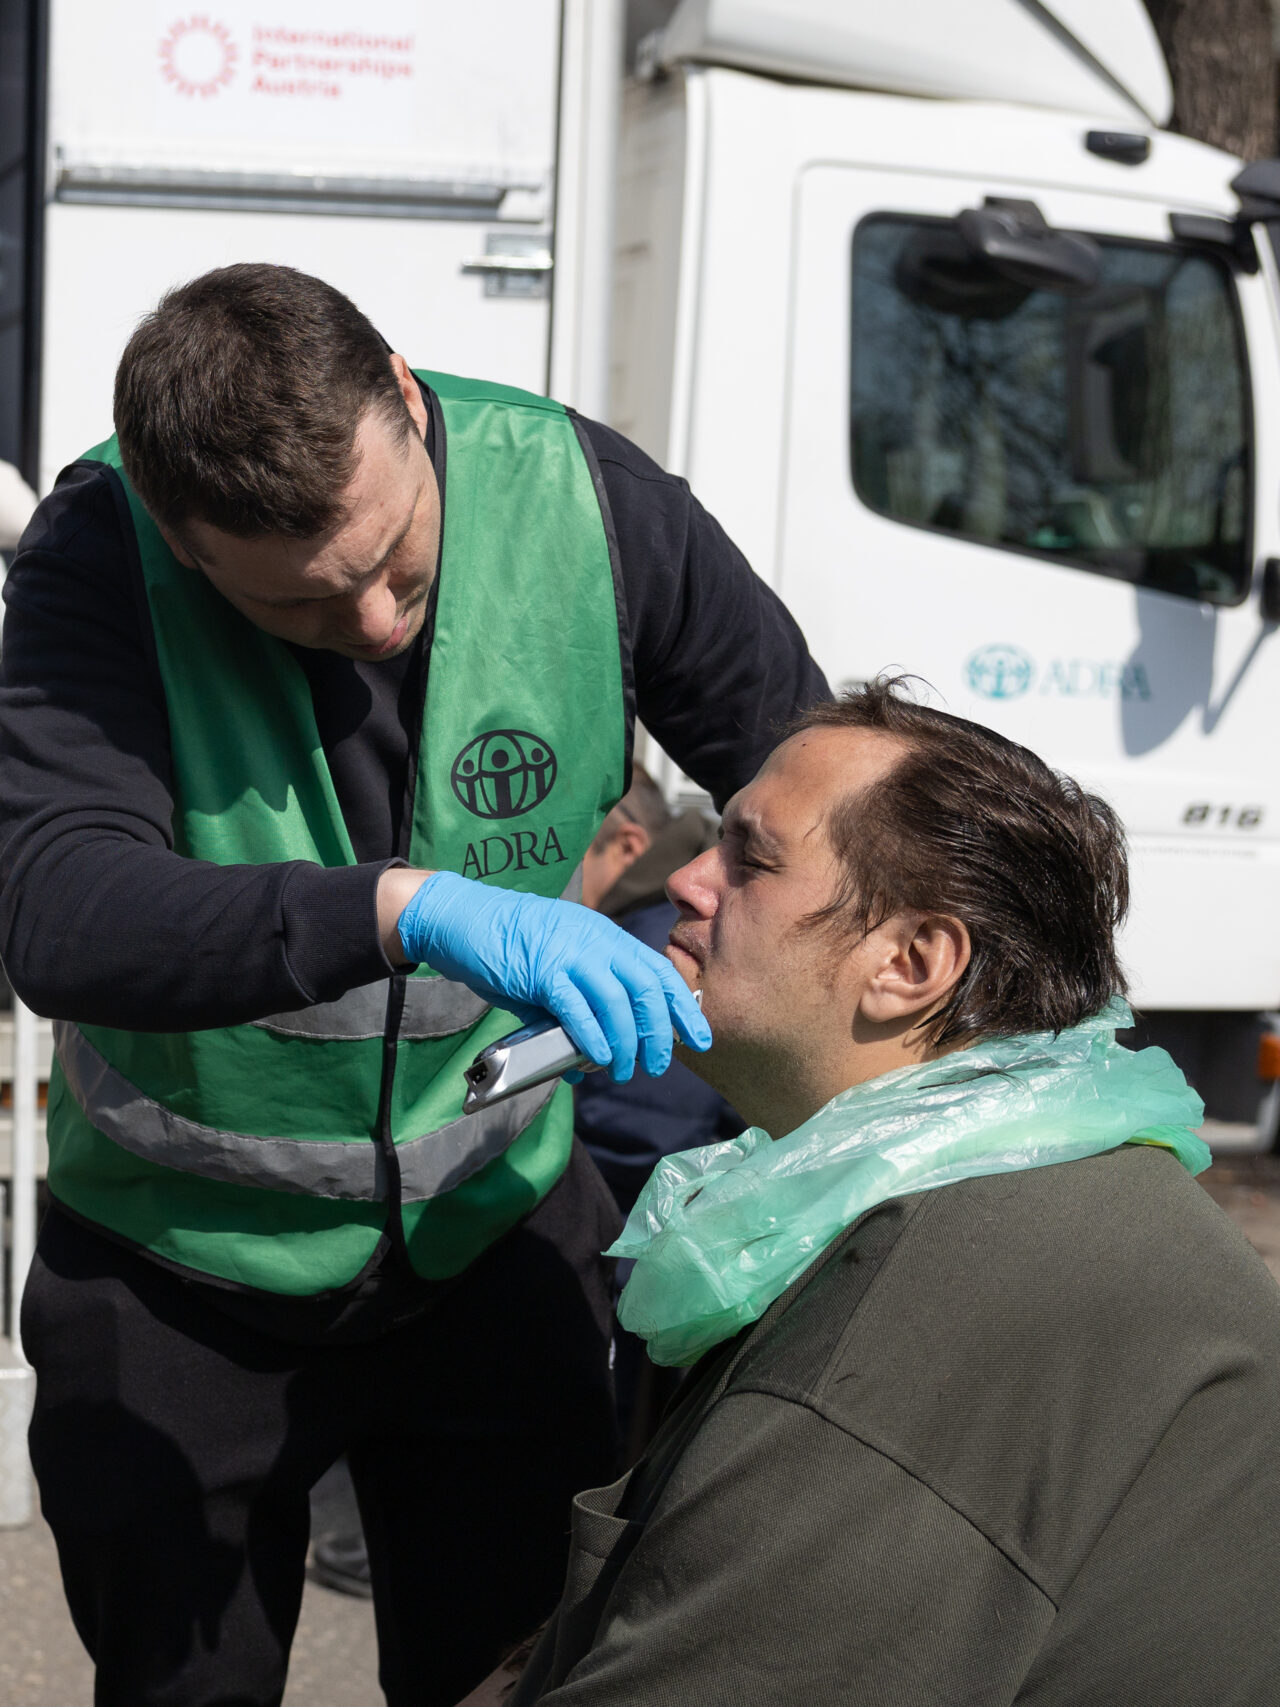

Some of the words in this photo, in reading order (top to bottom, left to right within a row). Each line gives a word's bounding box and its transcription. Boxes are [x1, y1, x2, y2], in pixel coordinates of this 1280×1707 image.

[252, 26, 413, 51] International
[252, 50, 412, 78] Partnerships
[252, 75, 340, 98] Austria
[1040, 658, 1151, 700] ADRA
[462, 826, 568, 880] ADRA
